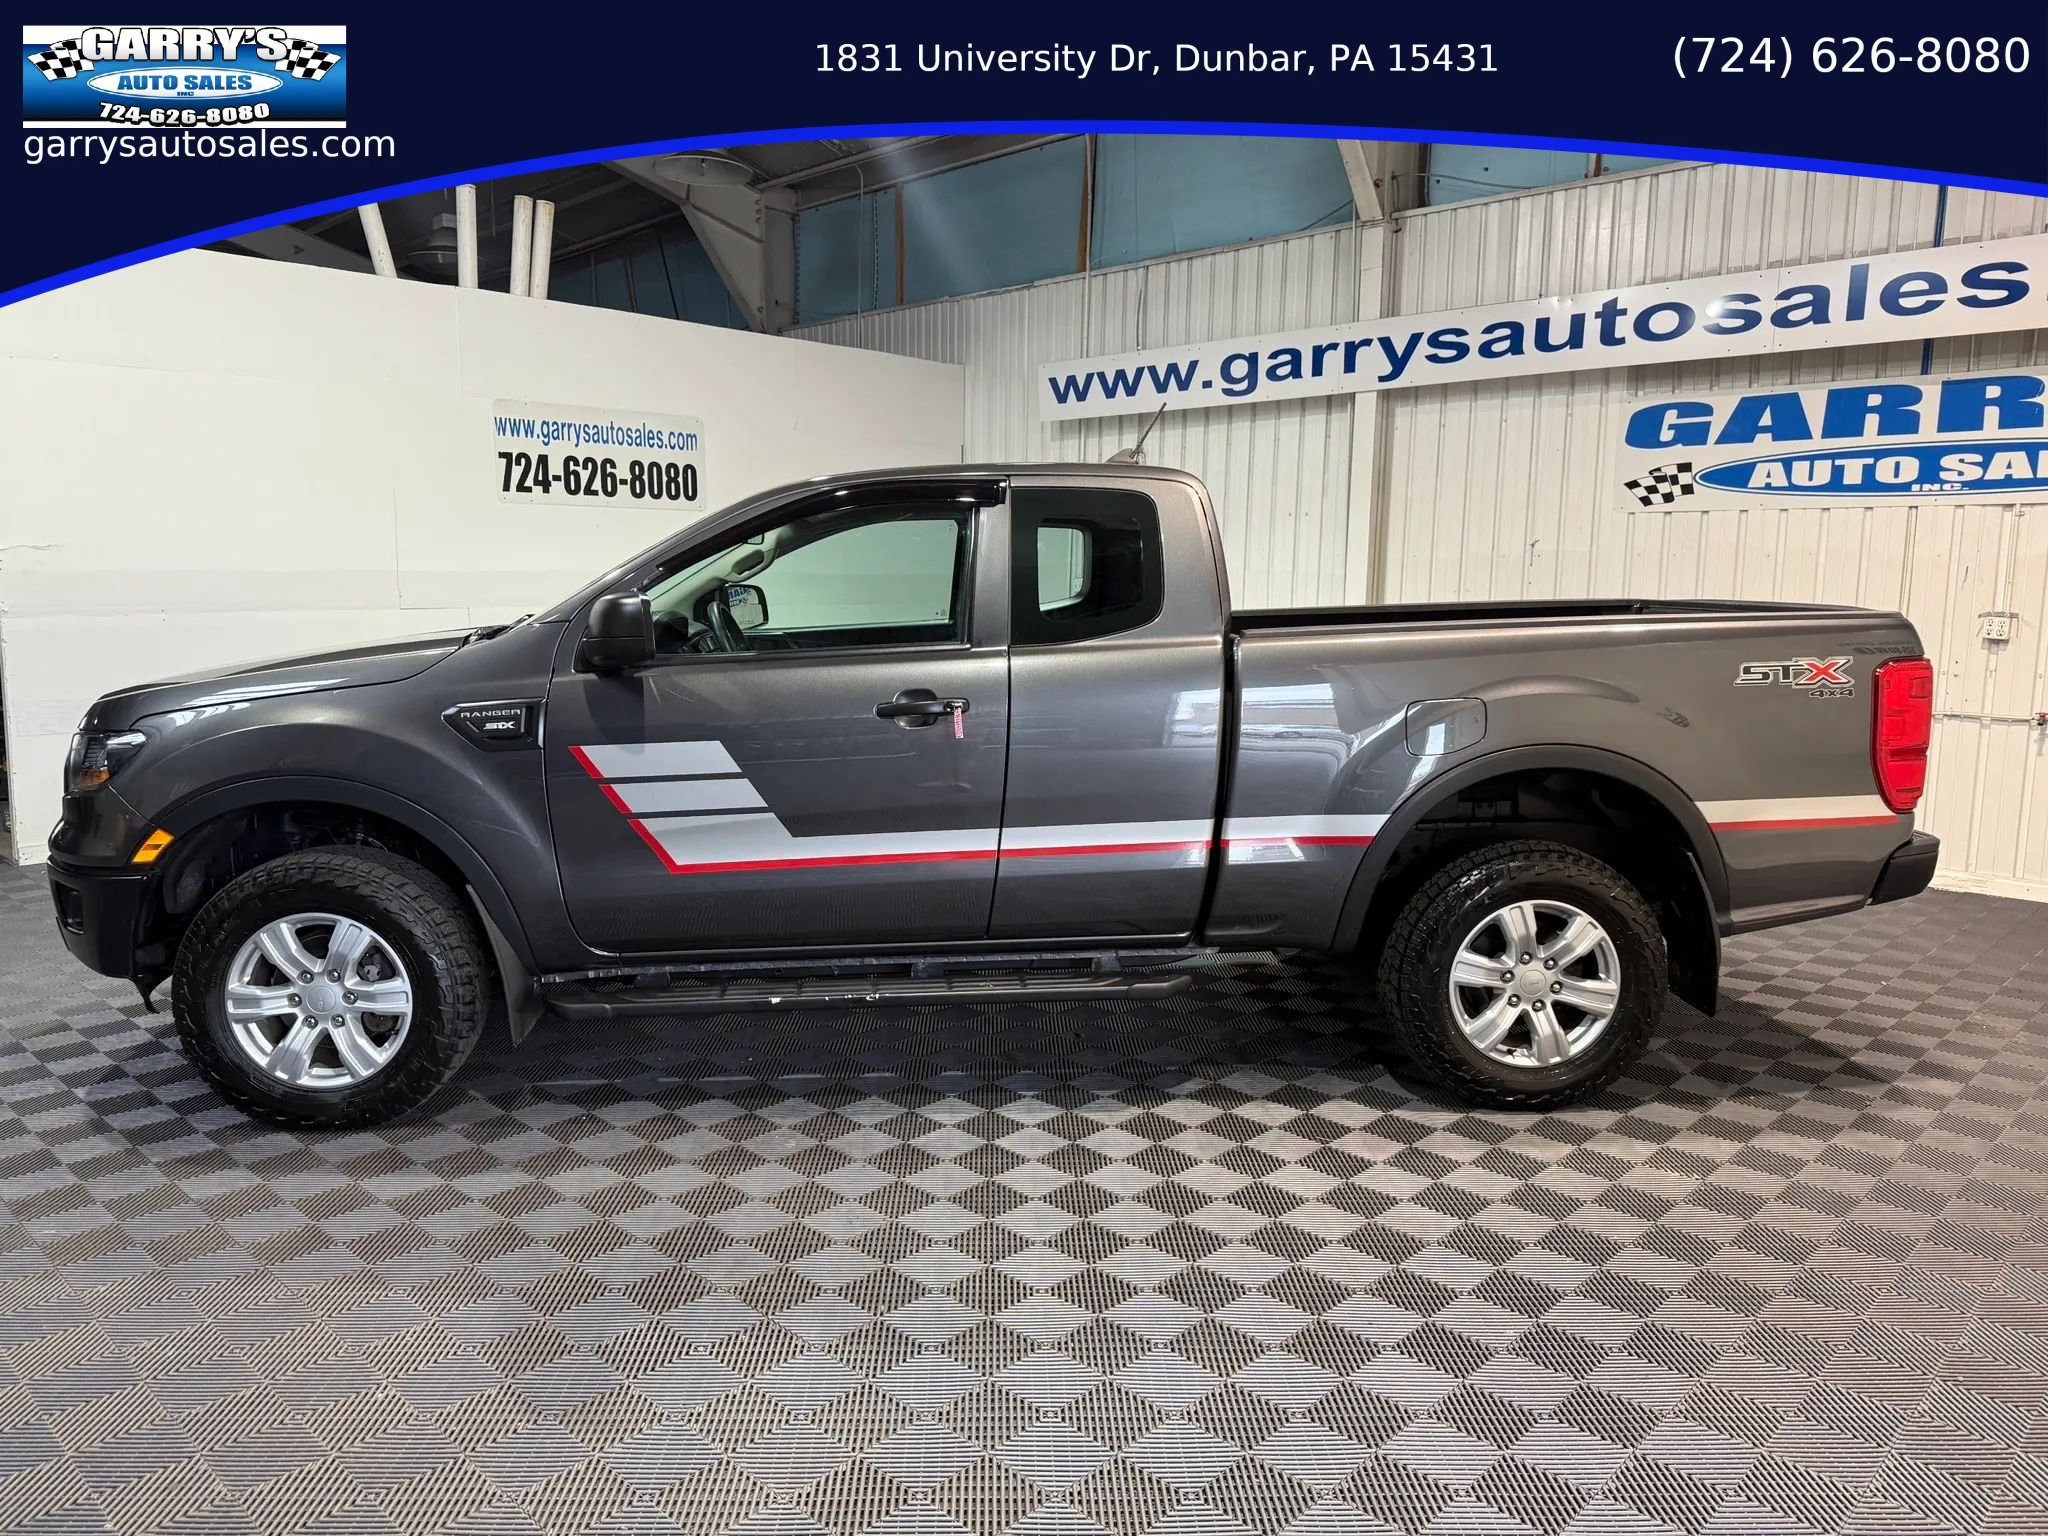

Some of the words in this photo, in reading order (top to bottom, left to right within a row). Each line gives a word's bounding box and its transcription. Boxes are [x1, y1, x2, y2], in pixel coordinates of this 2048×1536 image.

[1048, 260, 2048, 405] www.garrysautosales
[1625, 375, 2046, 449] GARR
[494, 416, 698, 451] www.garrysautosales.com
[498, 451, 698, 502] 724-626-8080
[1747, 456, 1920, 488] AUTO
[1939, 450, 2048, 482] SA
[1911, 482, 1970, 492] INC.
[1735, 657, 1854, 687] STX
[461, 709, 521, 718] RANGER
